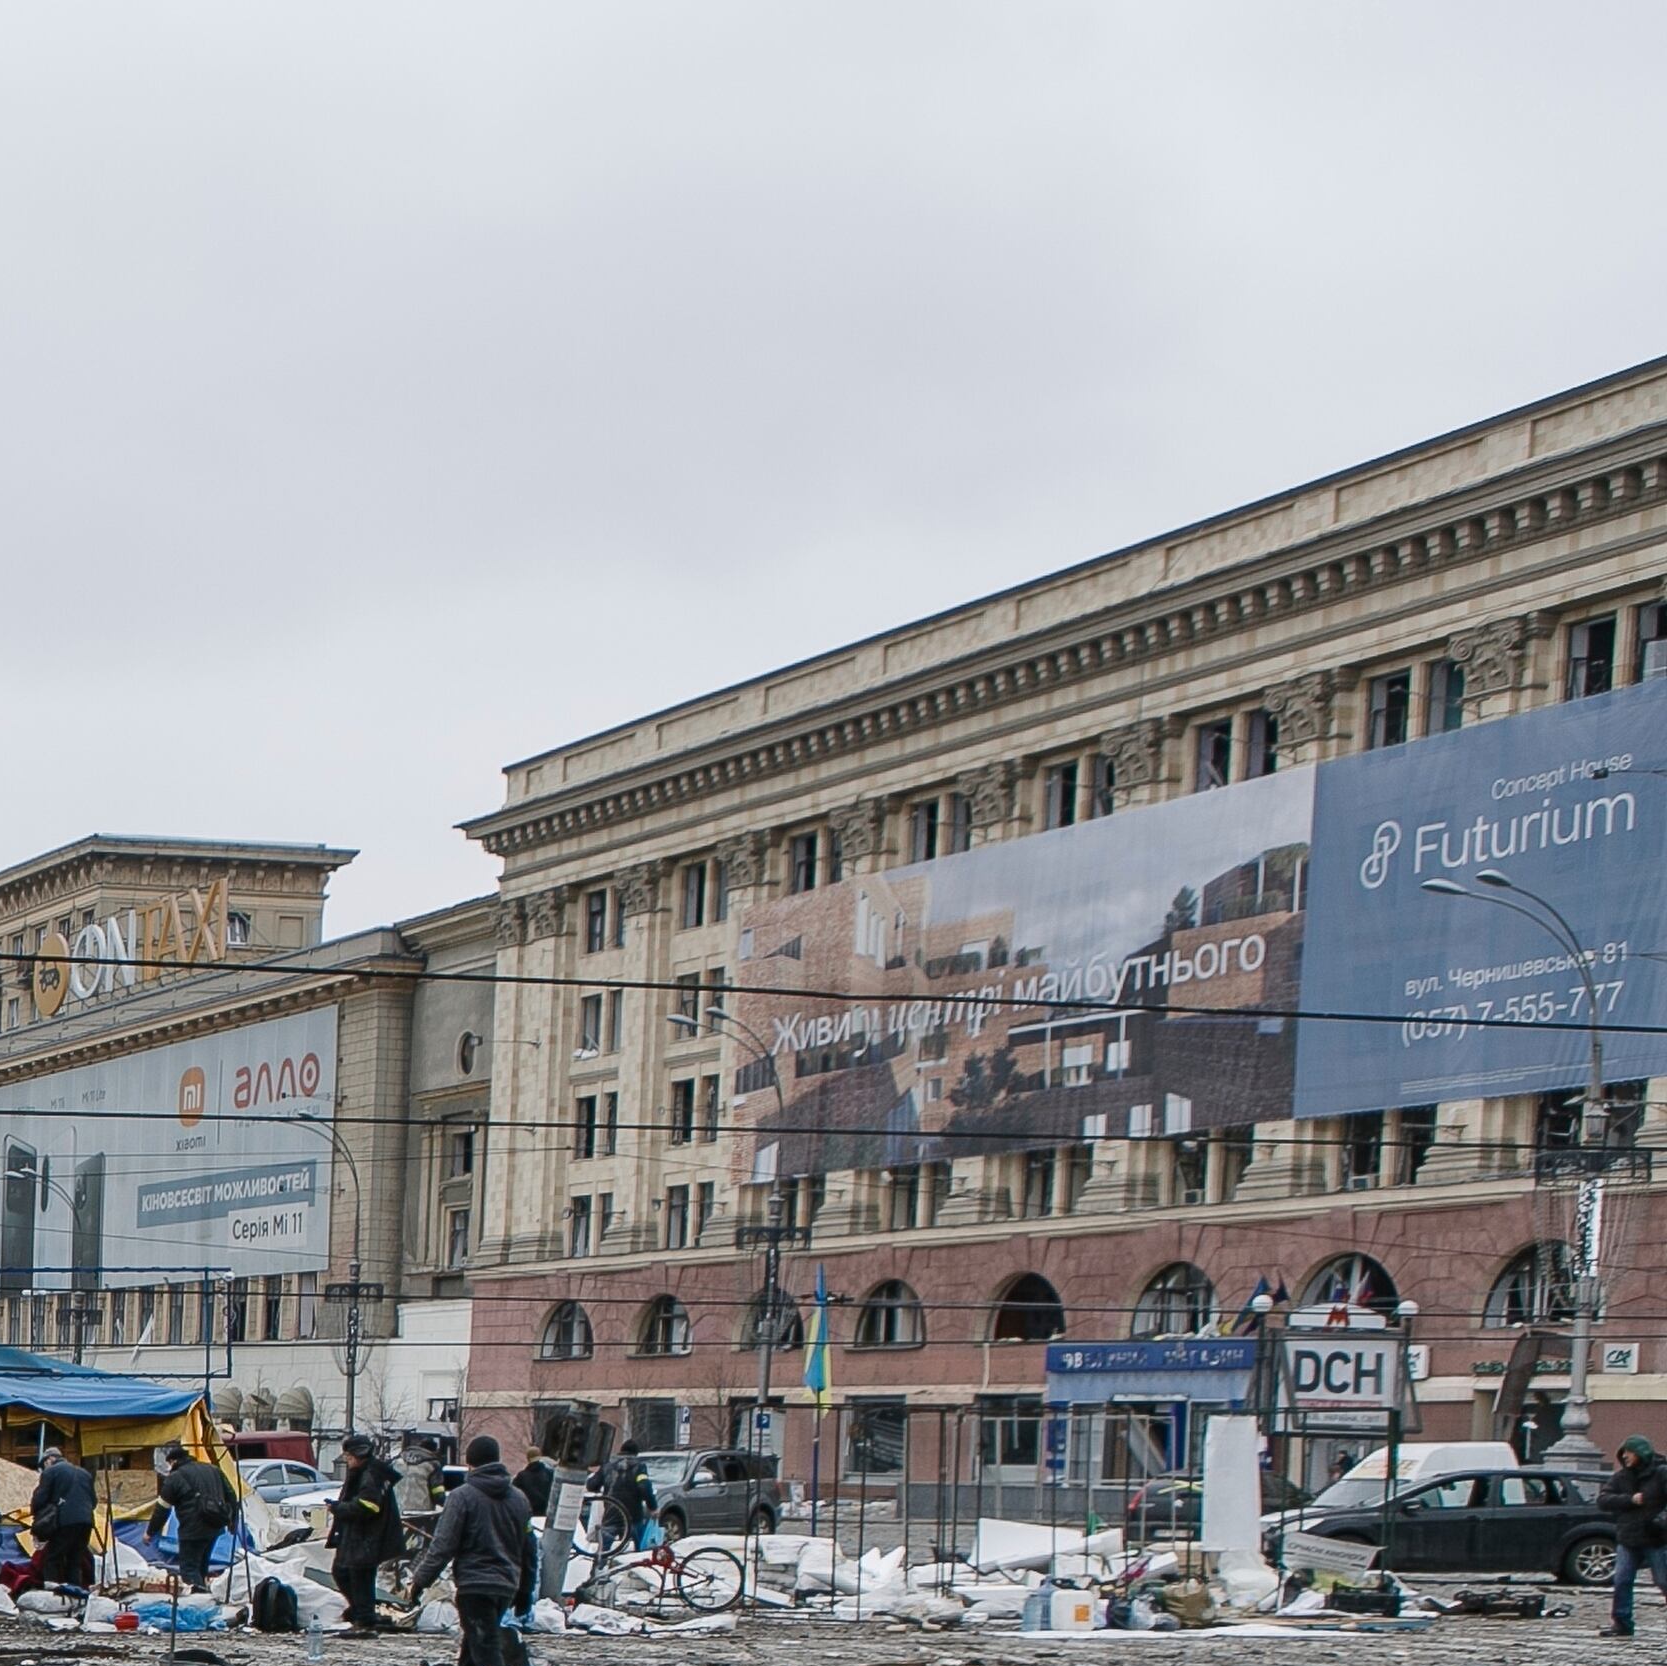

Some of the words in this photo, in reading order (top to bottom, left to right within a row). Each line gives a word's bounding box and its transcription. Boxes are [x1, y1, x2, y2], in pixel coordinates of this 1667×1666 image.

[1491, 767, 1566, 801] Concept
[1414, 793, 1635, 874] Futurium
[1404, 976, 1445, 999] вул.
[1448, 949, 1596, 990] Чернишевськ,
[1602, 940, 1628, 964] 81
[773, 1011, 852, 1056] Живи
[1011, 934, 1267, 1015] майбутнього
[1401, 1004, 1468, 1048] (057)
[142, 1185, 213, 1212] КІНОВСЕСВІТ
[215, 1169, 310, 1201] МОЖЛИВОСТЕЙ
[232, 1219, 269, 1242] Серія
[292, 1212, 303, 1233] 11
[1294, 1350, 1384, 1395] DCH
